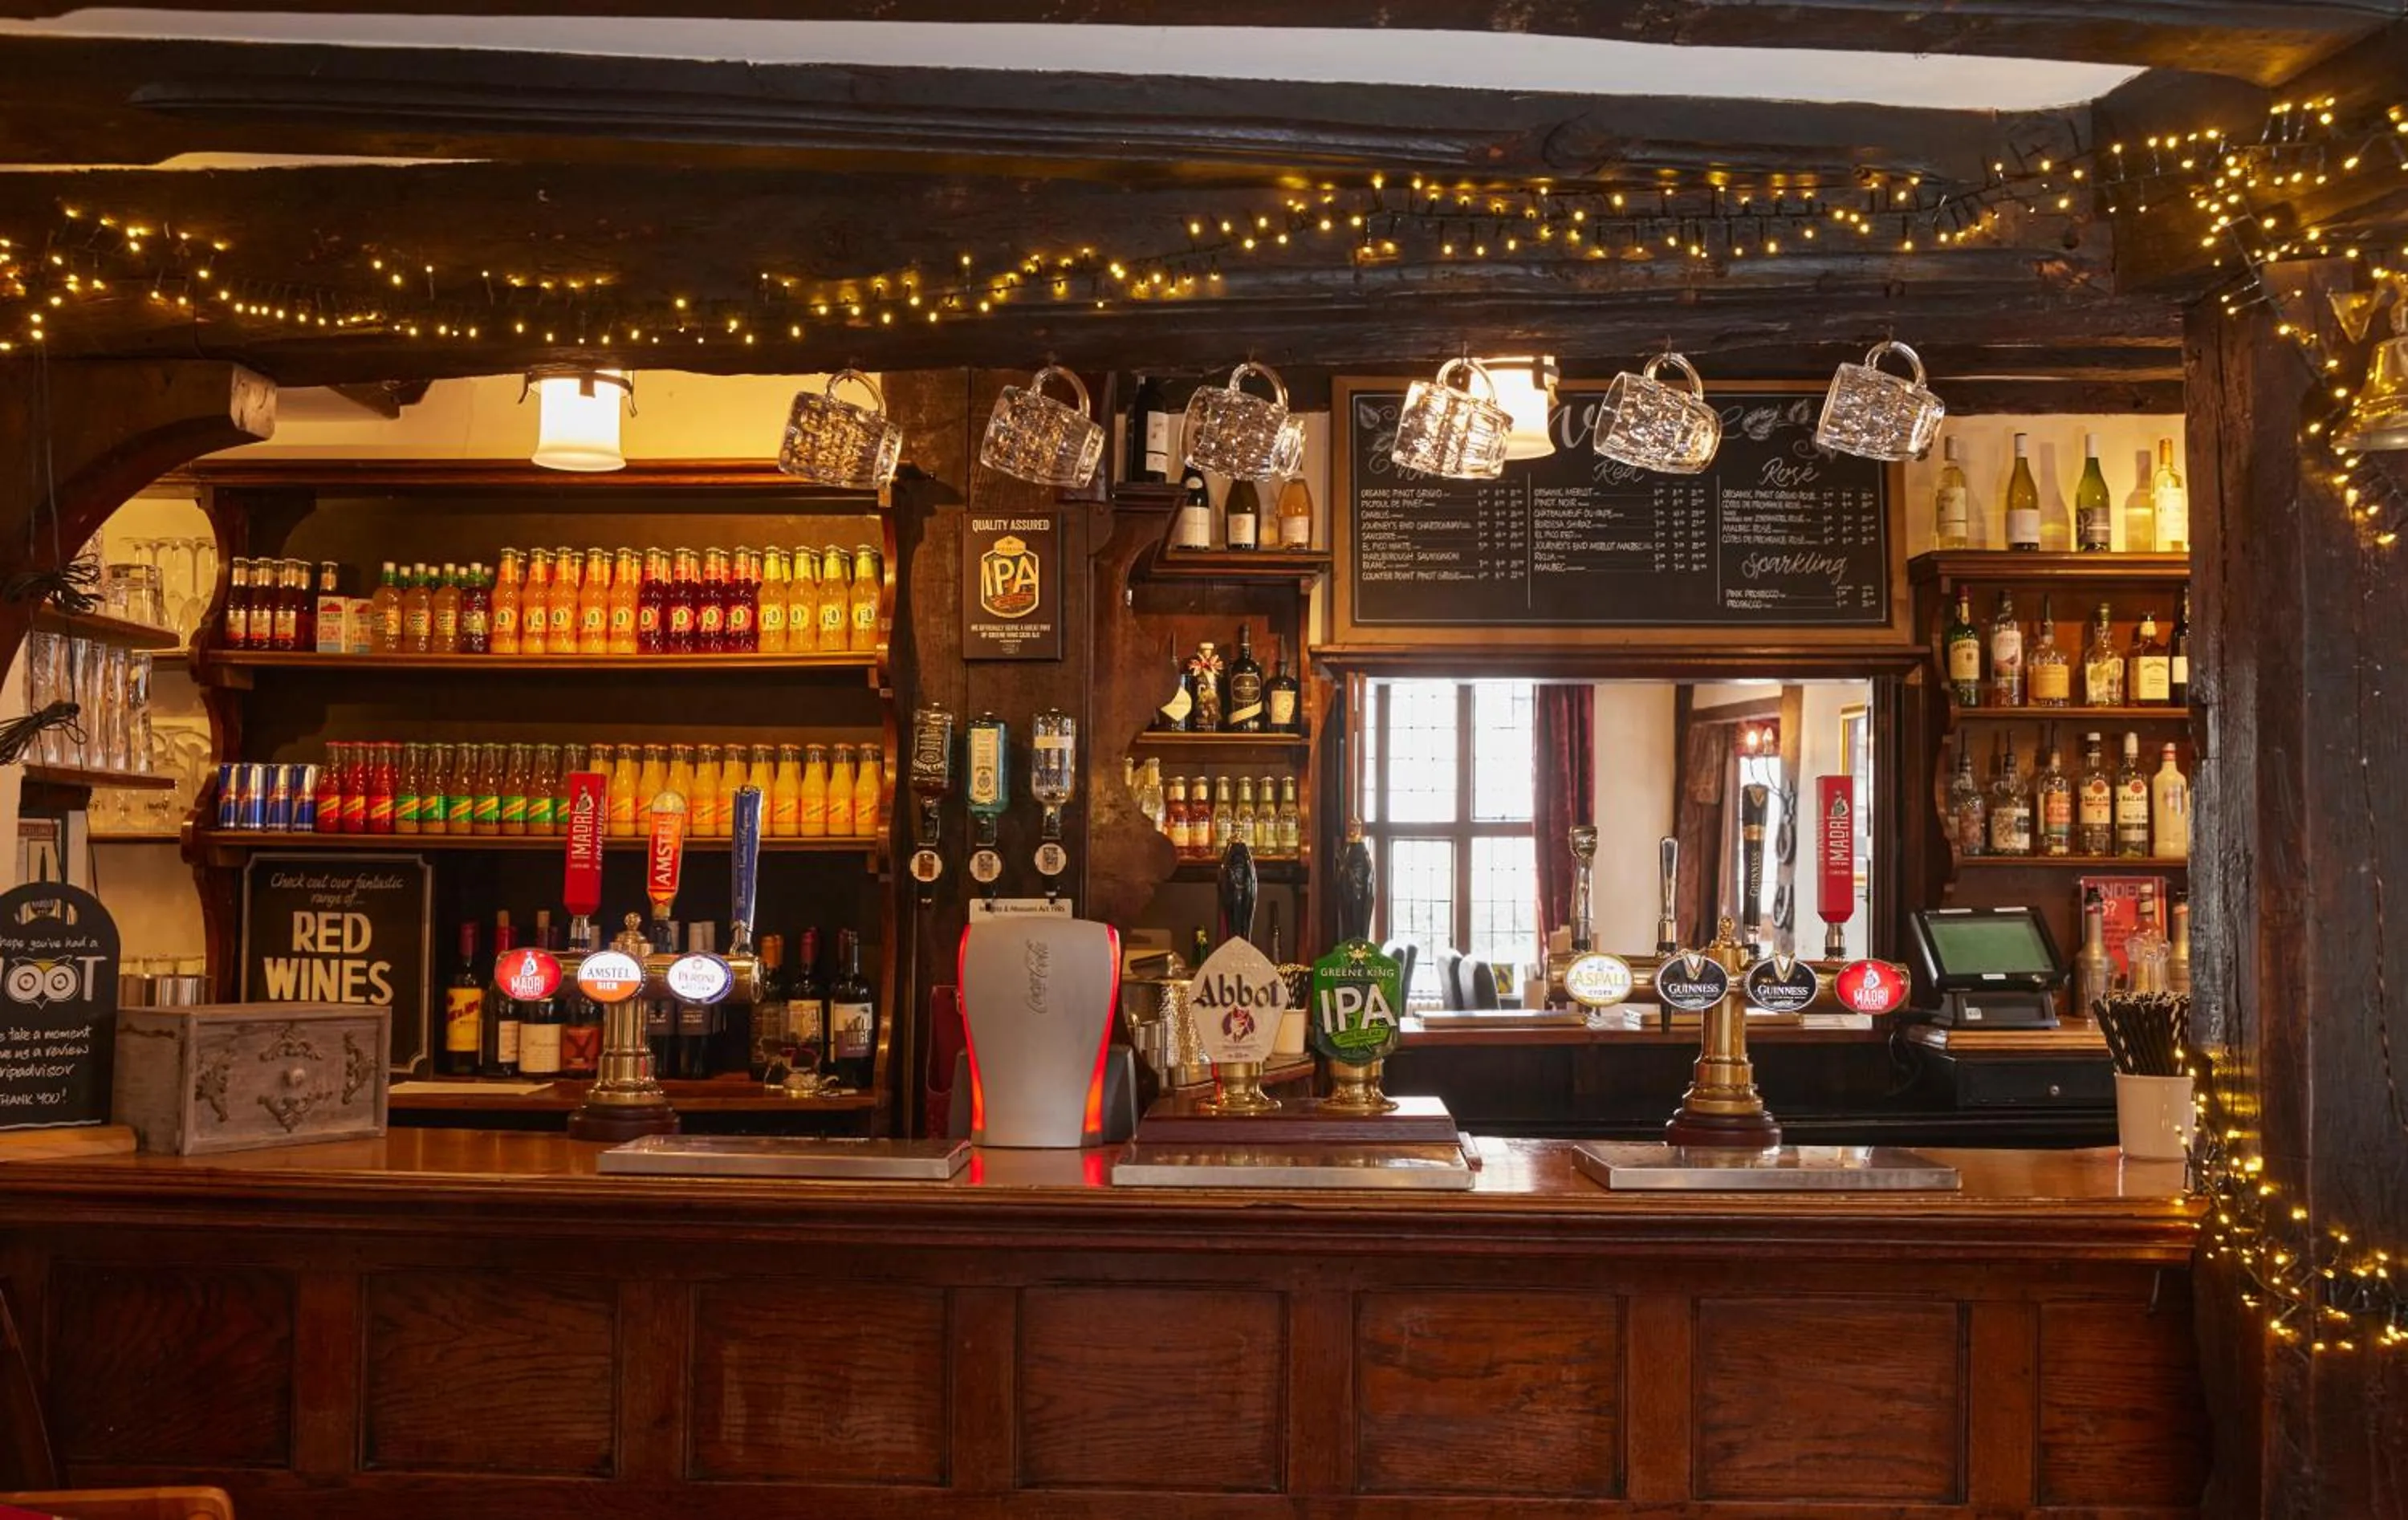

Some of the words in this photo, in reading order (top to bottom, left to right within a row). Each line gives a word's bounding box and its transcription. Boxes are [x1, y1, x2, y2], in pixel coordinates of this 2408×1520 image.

[1758, 457, 1820, 487] Rosé
[972, 519, 1010, 533] QUALITY
[1011, 519, 1051, 530] ASSURED
[981, 555, 1038, 596] IPA
[1741, 551, 1848, 586] Sparkling
[654, 814, 675, 886] AMSTEL
[270, 872, 306, 889] Check
[307, 874, 329, 889] out
[330, 877, 354, 889] our
[354, 872, 405, 894] fantastic
[311, 893, 341, 908] range
[292, 911, 372, 953] RED
[66, 936, 87, 948] had
[89, 939, 99, 947] a
[587, 966, 632, 979] AMSTEL
[677, 971, 715, 983] PERONI
[1320, 967, 1363, 977] GREENE
[1366, 967, 1395, 977] KING
[1574, 969, 1629, 988] ASPALL
[263, 957, 394, 1006] WINES
[596, 981, 619, 990] BIER
[1667, 982, 1720, 995] GUINNESS
[1757, 984, 1810, 996] GUINNESS
[1192, 973, 1284, 1008] Abbot
[1320, 984, 1397, 1034] IPA
[9, 1026, 31, 1041] take
[33, 1029, 41, 1040] a
[44, 1025, 93, 1039] moment
[32, 1047, 43, 1057] a
[45, 1042, 90, 1058] review
[0, 1063, 75, 1082] ripadvisor
